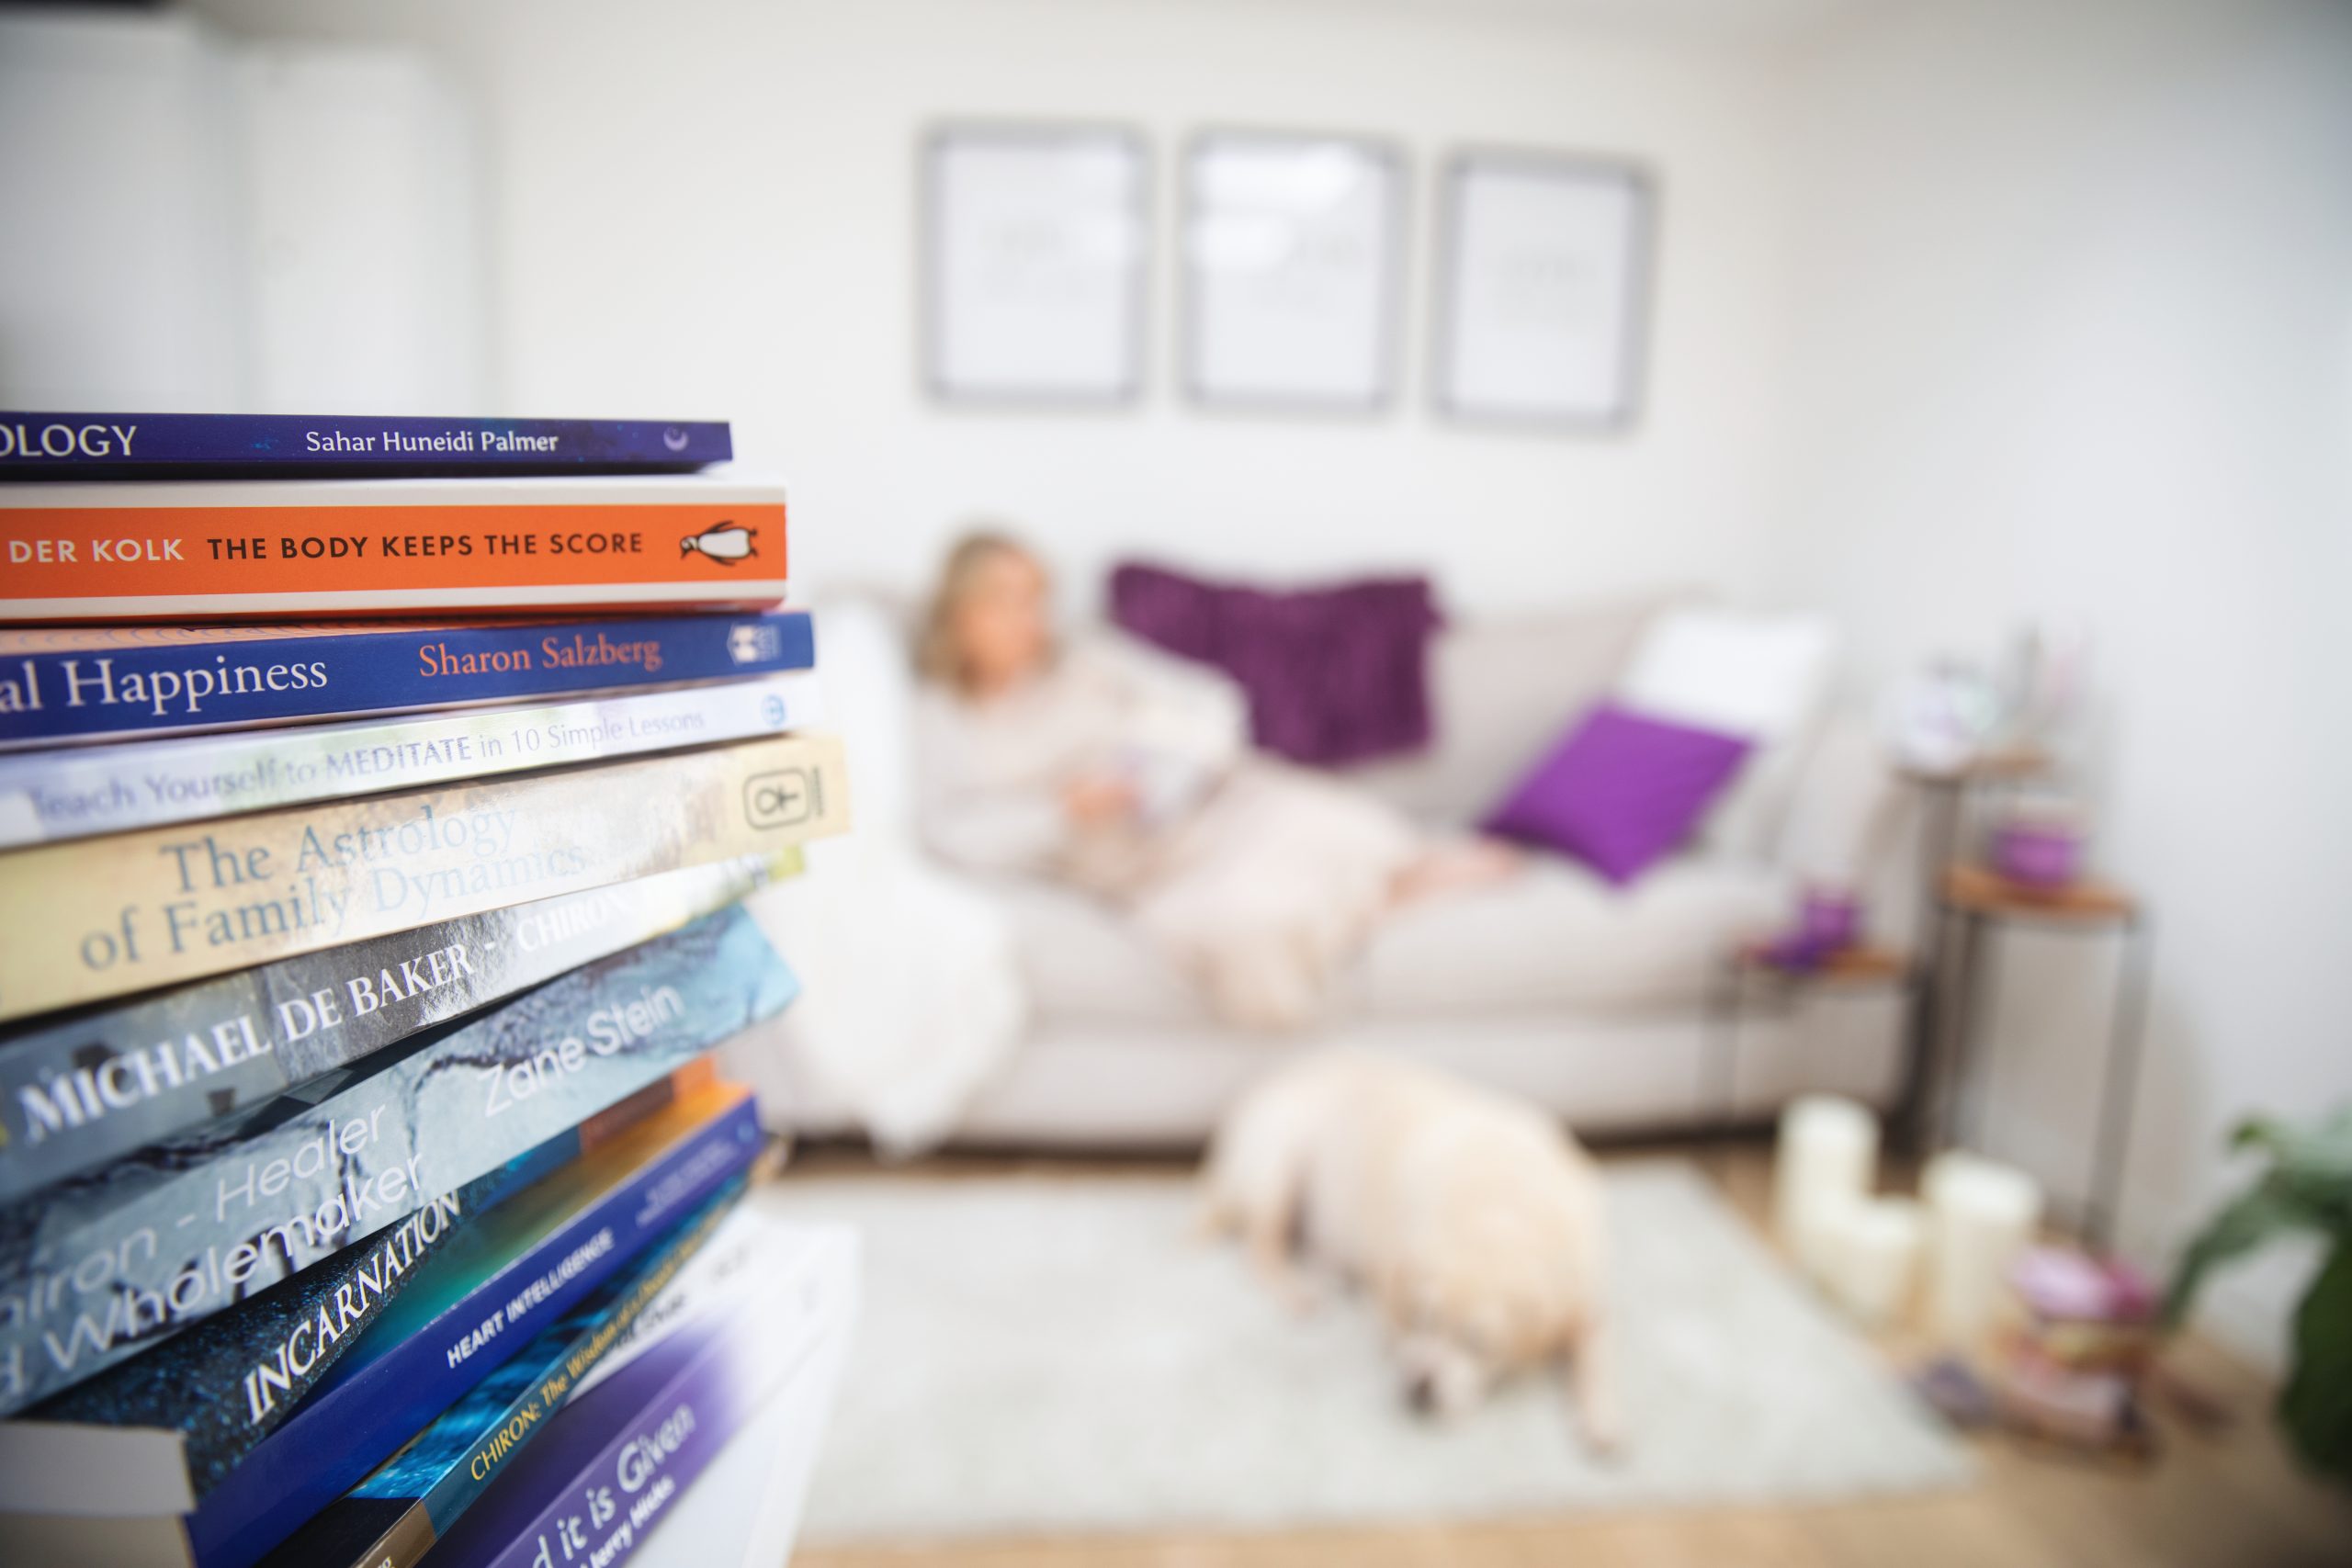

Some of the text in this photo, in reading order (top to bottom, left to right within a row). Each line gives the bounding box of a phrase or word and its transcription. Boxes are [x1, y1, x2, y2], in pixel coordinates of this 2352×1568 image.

[306, 431, 559, 452] Sahar Huneidi Palmer
[9, 538, 184, 563] DER KOLK
[207, 533, 642, 560] THE BODY KEEPS THE SCORE
[62, 655, 328, 716] Happiness
[419, 633, 662, 677] Sharon Salzberg
[29, 711, 704, 818] Teach Yourself to MEDITATE in 10 Simple Lessons
[81, 839, 586, 971] of Family Dynamics
[160, 804, 515, 894] The Astrology
[19, 1015, 272, 1146] MICHAEL
[278, 987, 341, 1043] DE
[347, 942, 475, 1017] BAKER
[479, 983, 684, 1119] Zane Stein
[217, 1103, 386, 1224] Healer
[43, 1153, 423, 1371] Wholemaker
[244, 1183, 461, 1426] INCARNATION
[447, 1311, 504, 1369] HEART
[506, 1226, 616, 1323] INTELLIGENCE
[470, 1402, 542, 1481] CHIRON:
[539, 1373, 569, 1407] The
[566, 1322, 617, 1379] Wisdom
[557, 1516, 588, 1561] it
[586, 1485, 616, 1530] is
[616, 1403, 696, 1493] Given
